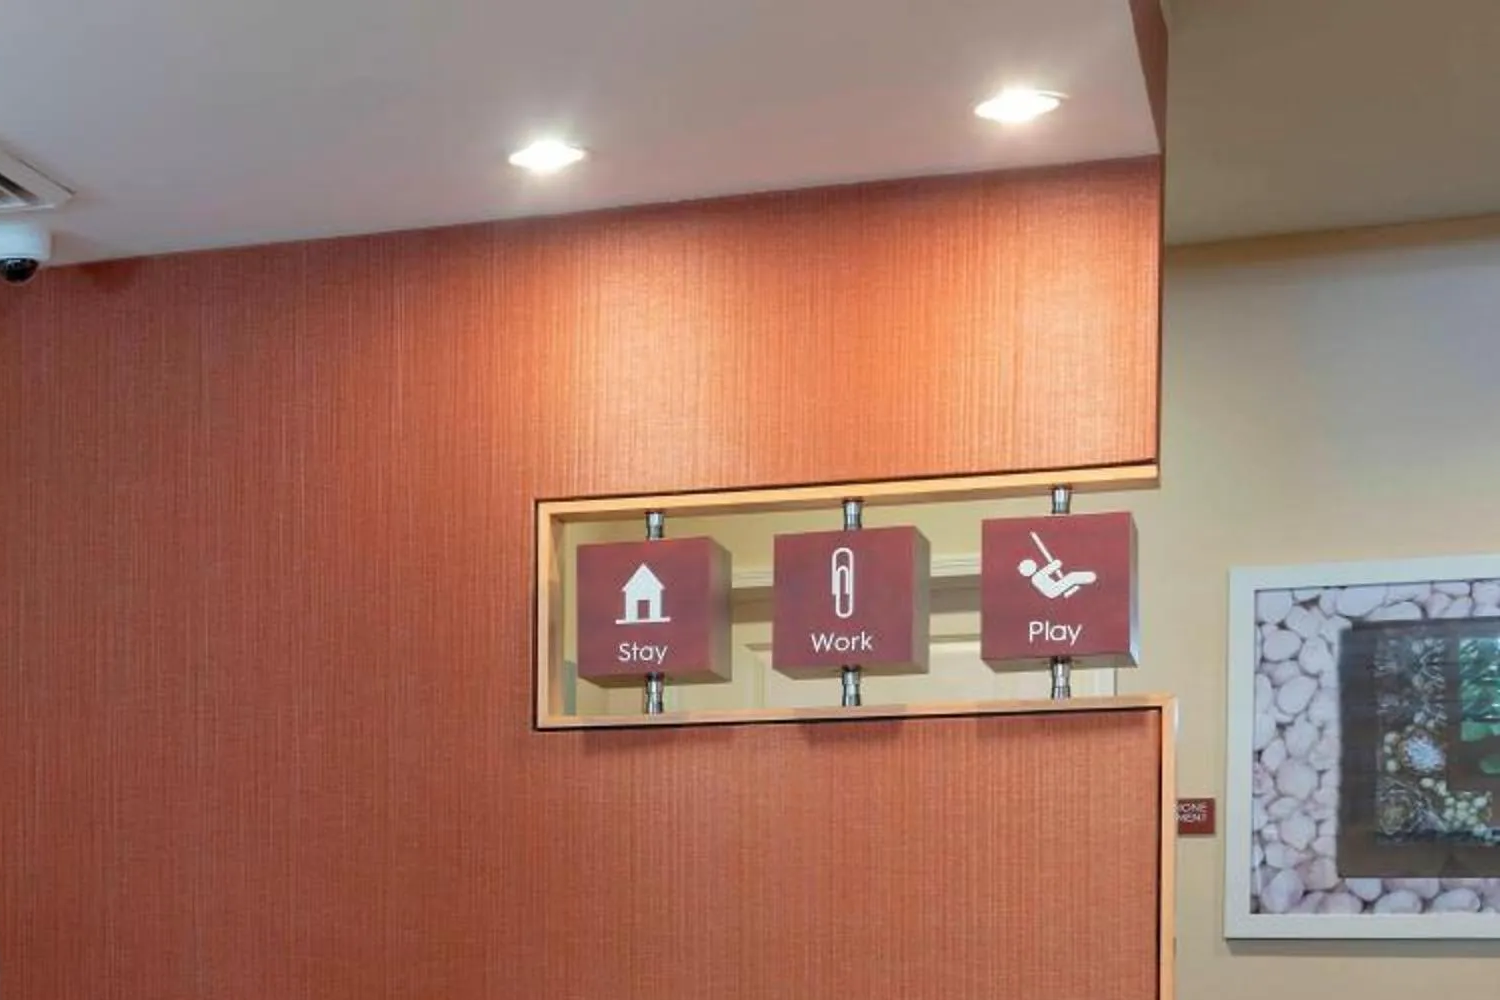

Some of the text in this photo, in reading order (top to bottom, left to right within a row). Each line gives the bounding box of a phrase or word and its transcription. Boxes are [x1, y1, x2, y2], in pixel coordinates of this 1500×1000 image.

[810, 631, 874, 653] Work
[1028, 620, 1083, 647] Play
[617, 641, 668, 665] Stay
